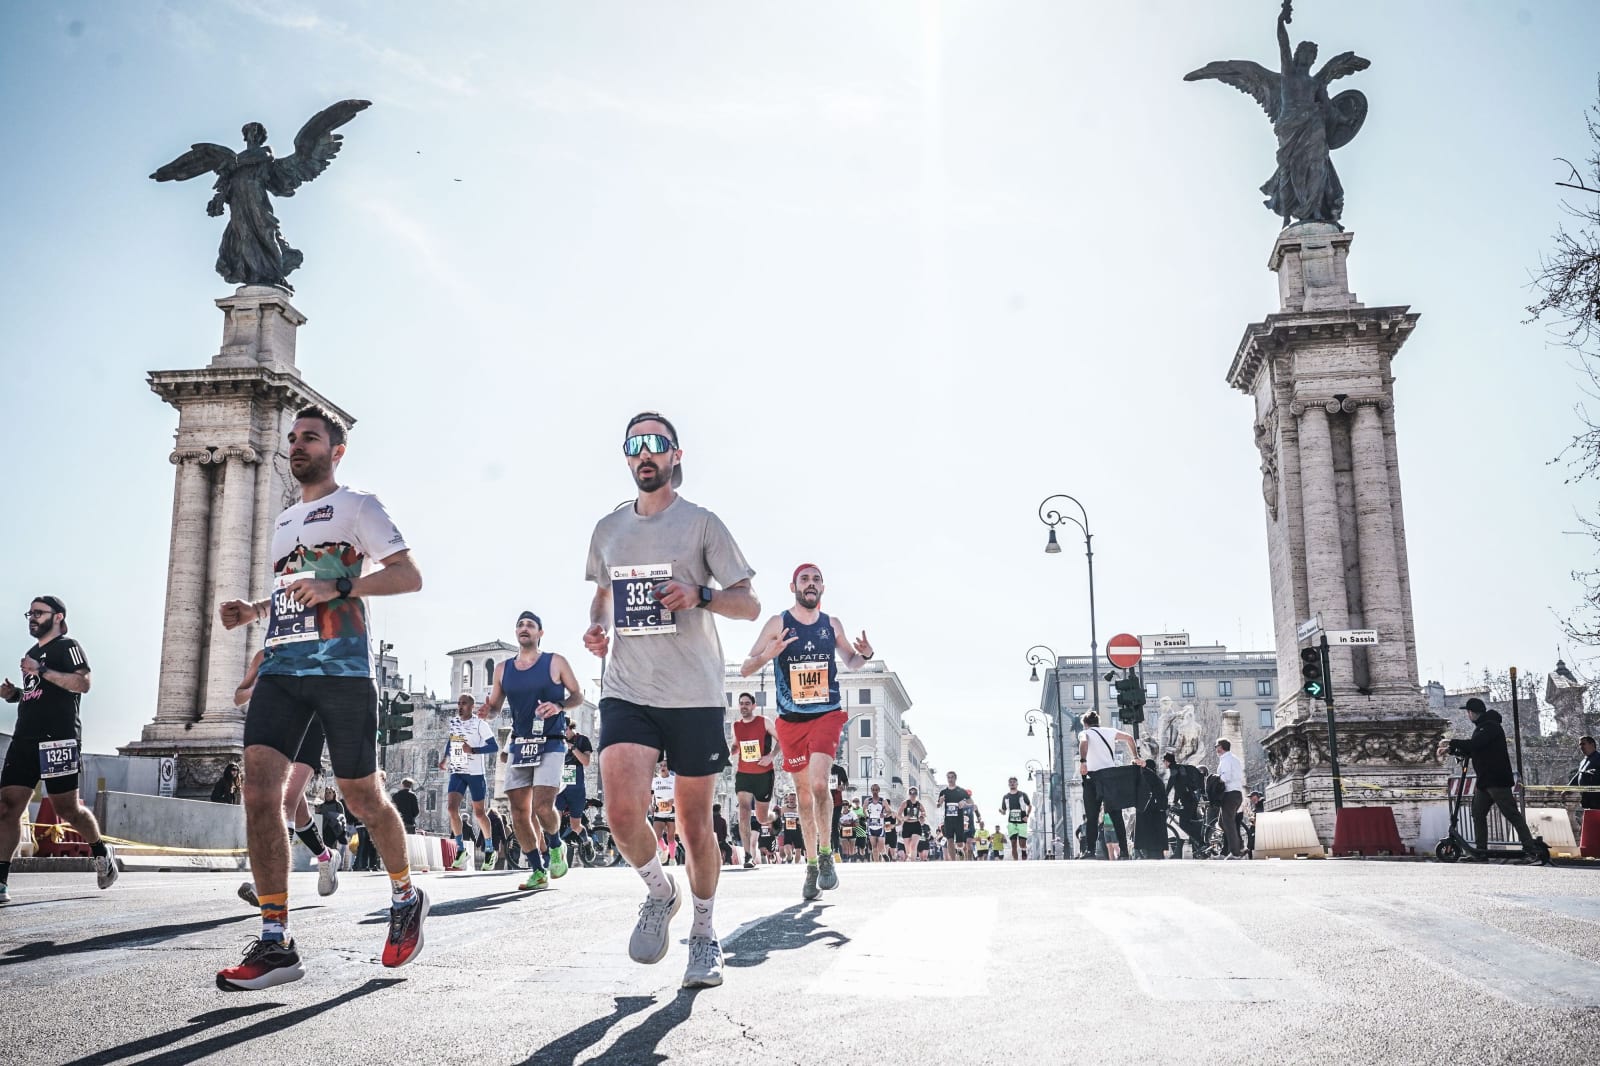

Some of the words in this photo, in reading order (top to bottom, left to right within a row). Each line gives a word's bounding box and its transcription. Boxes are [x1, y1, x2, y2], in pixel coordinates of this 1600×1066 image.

[1350, 635, 1375, 643] Sassia
[786, 653, 831, 662] ALFATEX
[797, 671, 821, 686] 11441
[46, 748, 73, 763] 13251
[520, 743, 538, 756] 4473
